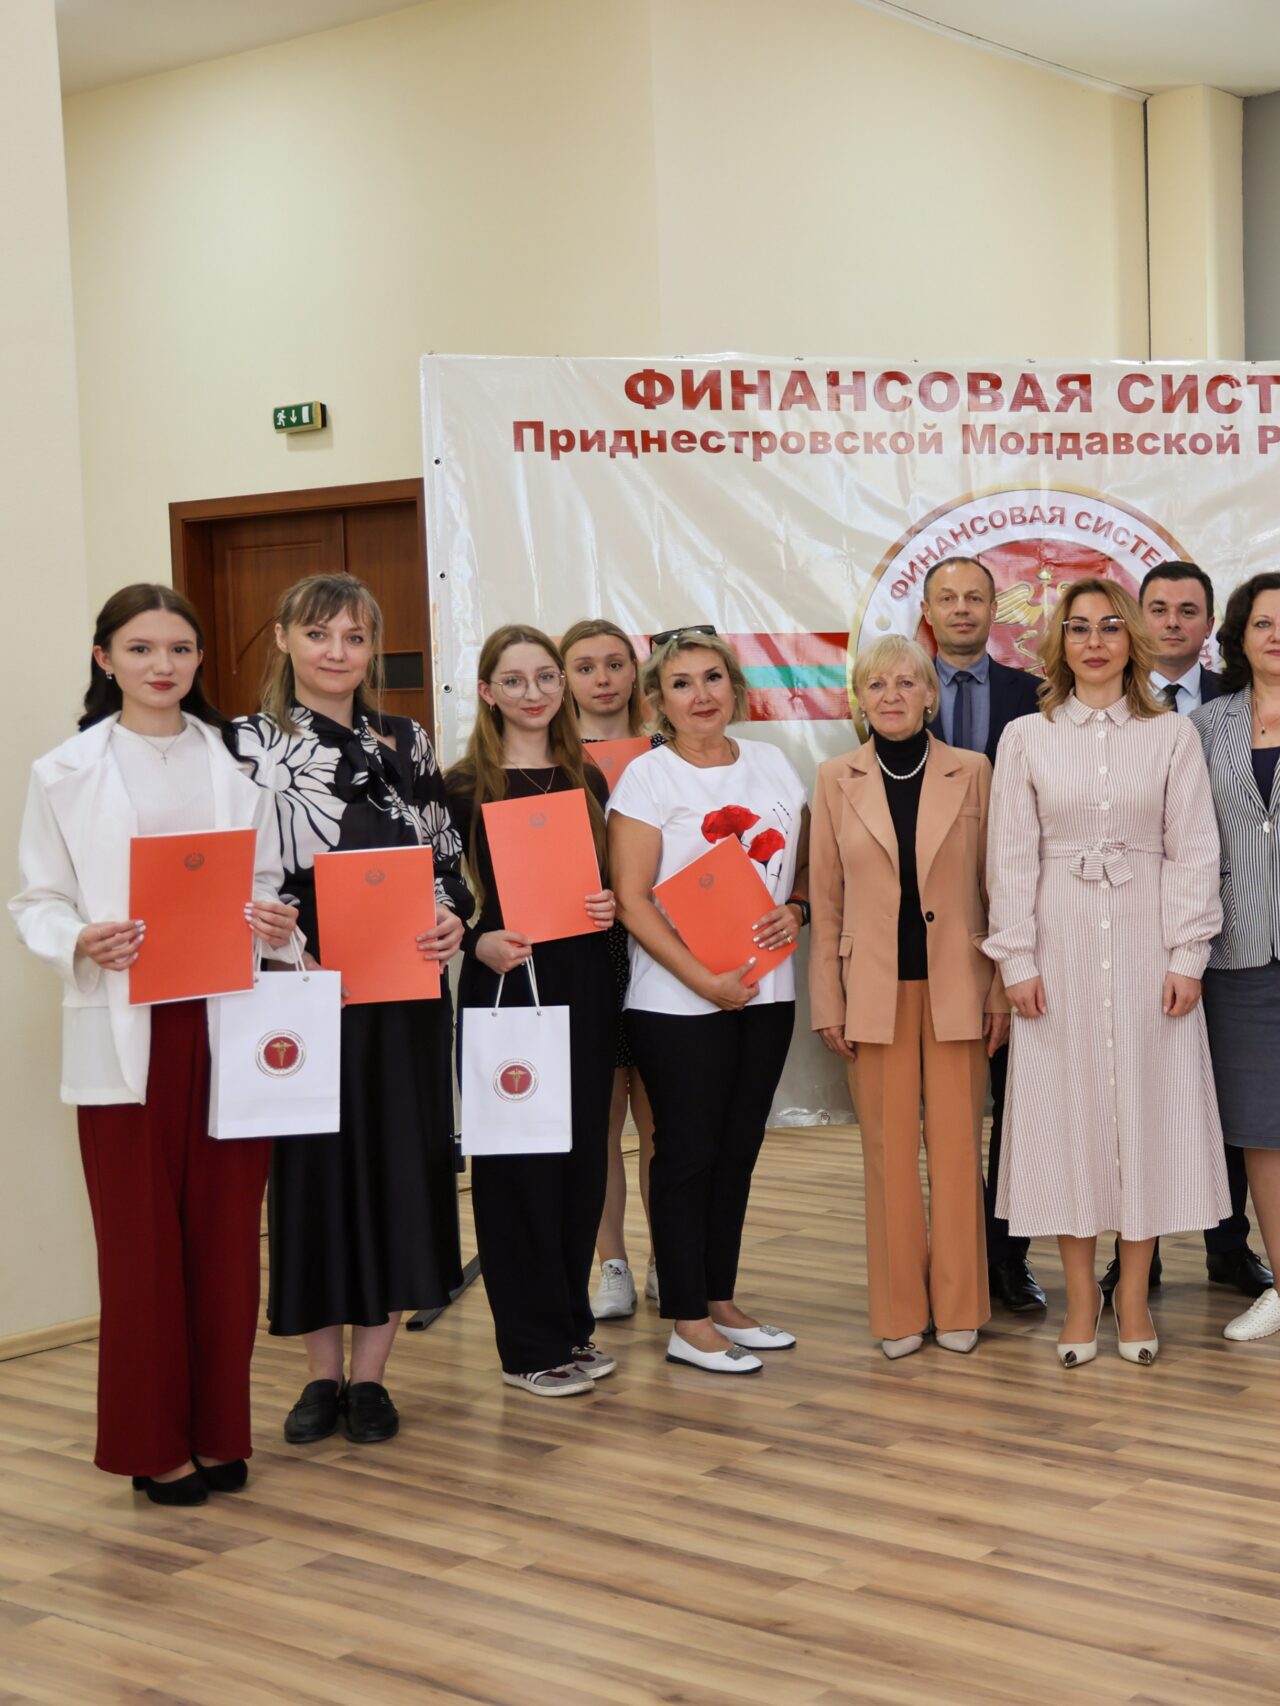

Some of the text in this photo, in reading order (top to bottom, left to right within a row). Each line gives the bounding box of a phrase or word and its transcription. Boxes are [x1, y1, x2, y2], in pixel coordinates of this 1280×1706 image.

[624, 367, 1093, 413] ФИНАНСОВАЯ
[512, 420, 944, 462] Приднестровской
[961, 422, 1241, 461] Молдавской
[890, 505, 1169, 601] ФИНАНСОВАЯ СИСТЕ
